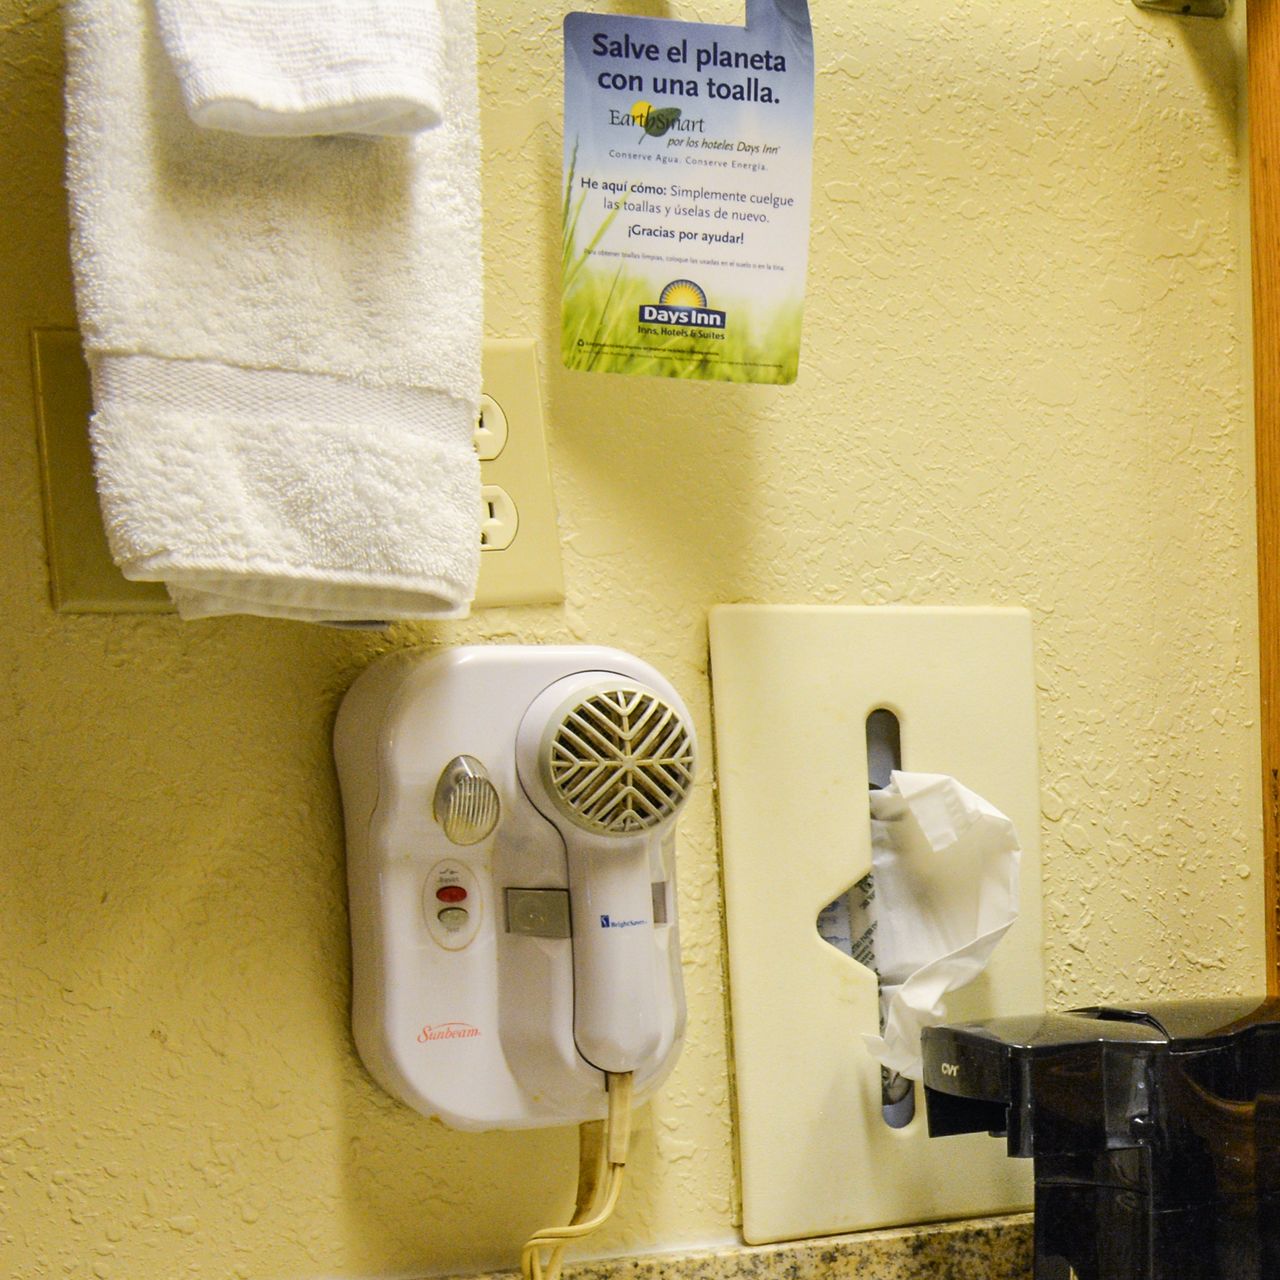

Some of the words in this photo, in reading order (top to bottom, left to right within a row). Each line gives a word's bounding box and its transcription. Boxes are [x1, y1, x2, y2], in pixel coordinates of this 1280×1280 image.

[592, 32, 660, 61] Salve
[666, 39, 688, 63] el
[696, 41, 787, 72] planeta
[597, 71, 643, 92] con
[652, 76, 699, 97] una
[706, 77, 780, 104] toalla.
[608, 105, 705, 133] EarthSmart
[667, 137, 685, 149] por
[686, 136, 699, 149] los
[701, 138, 734, 152] hoteles
[736, 142, 760, 155] Days
[608, 149, 652, 161] Conserve
[685, 156, 728, 168] Conserve
[580, 177, 599, 190] He
[601, 181, 627, 195] aquí
[630, 182, 667, 196] cómo:
[670, 185, 747, 203] Simplemente
[749, 193, 794, 208] cuelgue
[603, 197, 620, 210] las
[623, 200, 661, 214] toallas
[664, 205, 672, 217] y
[674, 204, 711, 218] úselas
[713, 208, 729, 219] de
[731, 212, 770, 223] nuevo.
[627, 224, 675, 239] ¡Gracias
[678, 229, 699, 242] por
[701, 231, 745, 244] ayudar!
[644, 306, 689, 324] Days
[691, 310, 722, 326] Inn
[637, 325, 659, 336] Inns,
[660, 327, 689, 338] Hotels
[690, 329, 697, 338] &
[698, 329, 726, 340] Suites
[417, 1023, 480, 1044] Sunbeam
